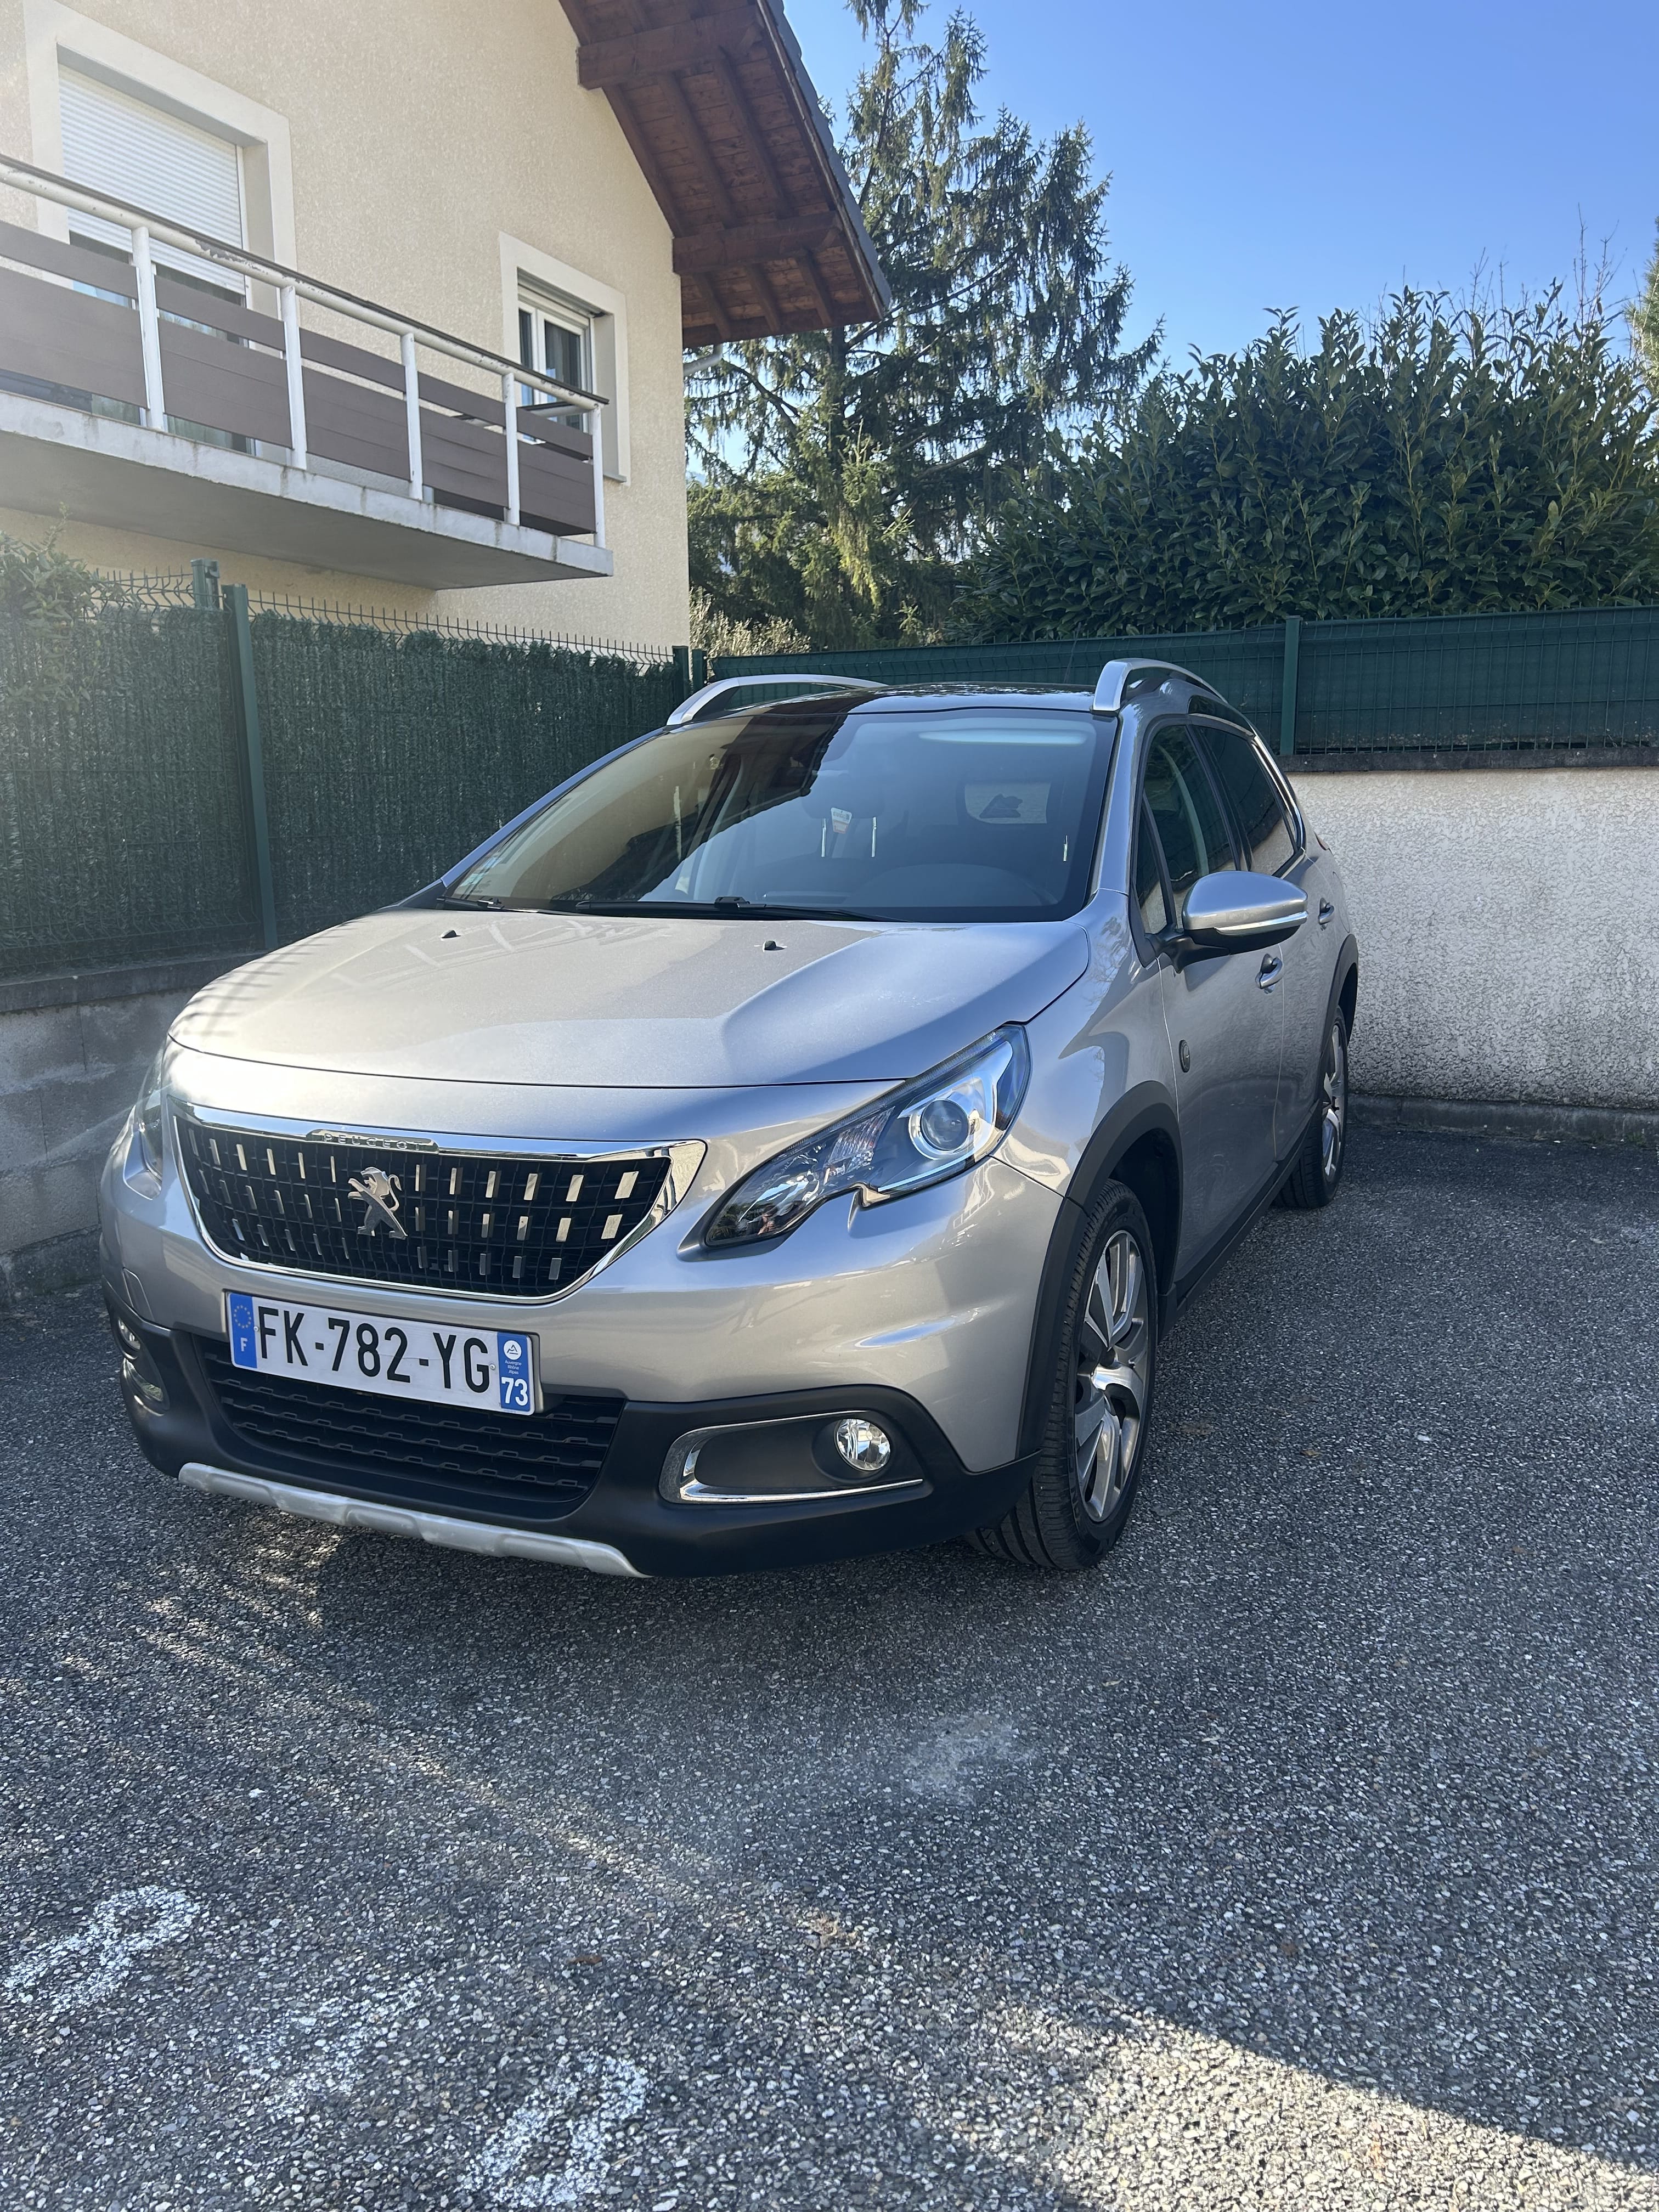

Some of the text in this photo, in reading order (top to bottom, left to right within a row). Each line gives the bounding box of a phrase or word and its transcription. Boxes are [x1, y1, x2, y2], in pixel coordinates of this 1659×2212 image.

[324, 1133, 422, 1151] PEUGEOT
[240, 1337, 248, 1352] F
[258, 1306, 490, 1393] FK-782-YG
[501, 1376, 528, 1406] 73
